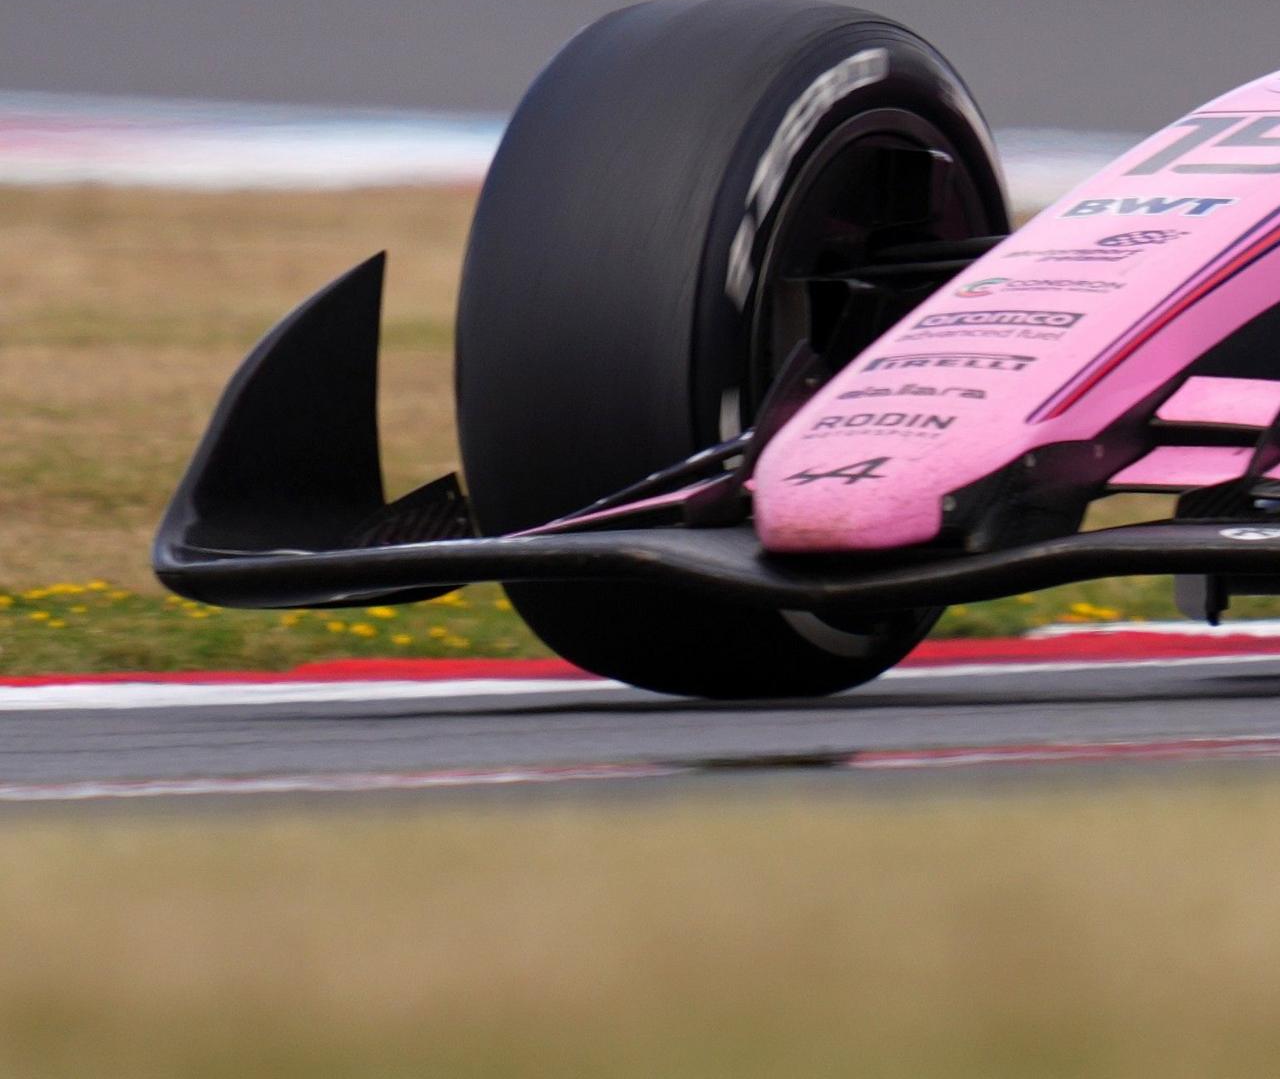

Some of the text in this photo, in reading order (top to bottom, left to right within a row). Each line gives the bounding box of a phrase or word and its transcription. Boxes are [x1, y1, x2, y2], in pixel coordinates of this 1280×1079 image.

[1061, 197, 1235, 218] BWT
[918, 310, 1076, 328] aramco
[861, 352, 1038, 372] PIRELLI
[811, 412, 958, 431] RODIN
